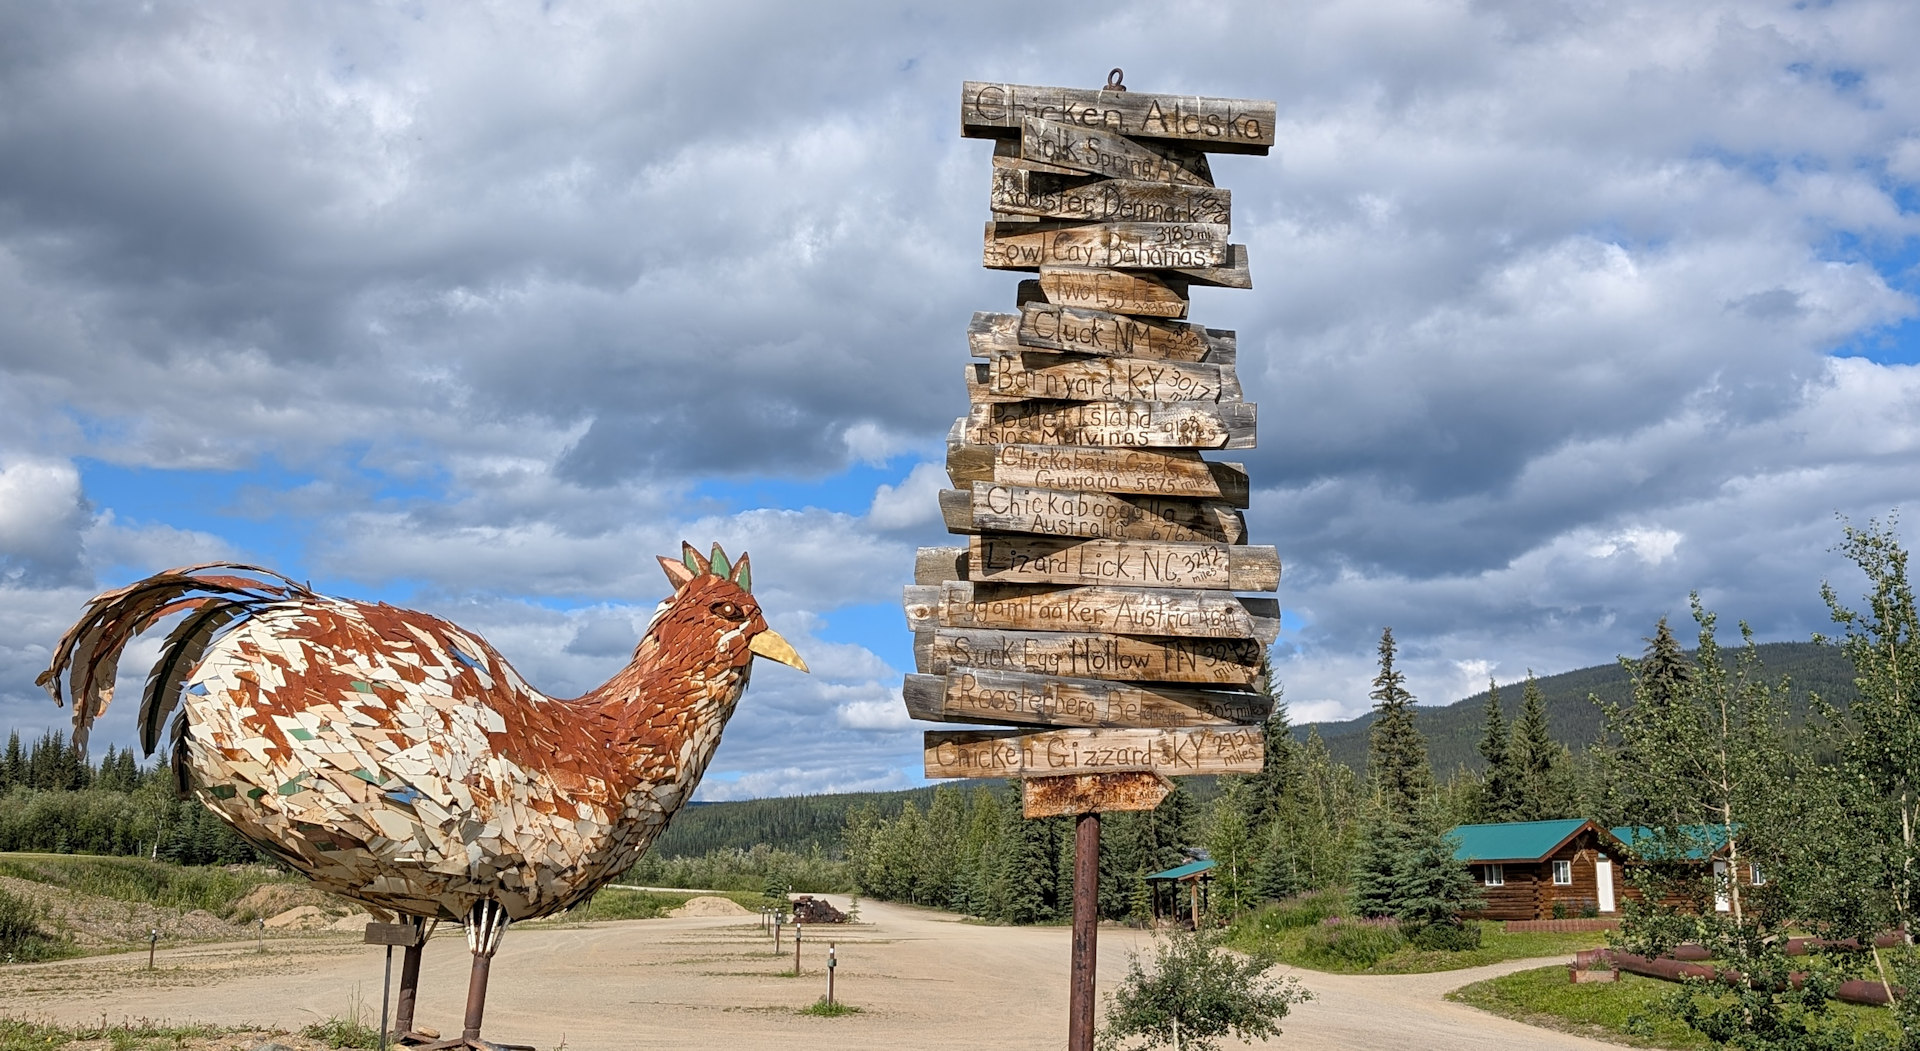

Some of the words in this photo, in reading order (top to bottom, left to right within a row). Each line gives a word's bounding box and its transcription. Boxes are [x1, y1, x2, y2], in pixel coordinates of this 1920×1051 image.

[1141, 100, 1264, 140] Alaska
[1029, 124, 1081, 162] Yolk
[1103, 184, 1200, 222] Denmark
[1107, 232, 1206, 267] Bahamas
[1155, 225, 1194, 244] 3985
[1048, 273, 1090, 301] Two
[1133, 302, 1163, 315] 3335
[1166, 370, 1211, 400] 3017
[989, 402, 1071, 430] Poulet
[1077, 402, 1152, 430] Island
[1036, 470, 1120, 490] Guyana
[1133, 477, 1176, 493] 5675
[1181, 474, 1211, 490] miles
[1150, 523, 1194, 542] 6763
[1200, 529, 1228, 543] miles
[987, 542, 1069, 575] Lizard
[1181, 545, 1222, 573] 3242
[1192, 566, 1218, 583] miles
[1113, 595, 1192, 628] Austria
[1209, 626, 1242, 637] miles
[950, 636, 1016, 667] Suck
[1024, 637, 1060, 675] Egg
[1071, 637, 1150, 673] Hollow
[960, 673, 1096, 722] Roosterberg
[1237, 699, 1265, 717] miles
[936, 735, 1034, 769] Chicken
[1173, 732, 1206, 769] KY
[1212, 729, 1254, 755] 2951
[1223, 746, 1257, 767] miles
